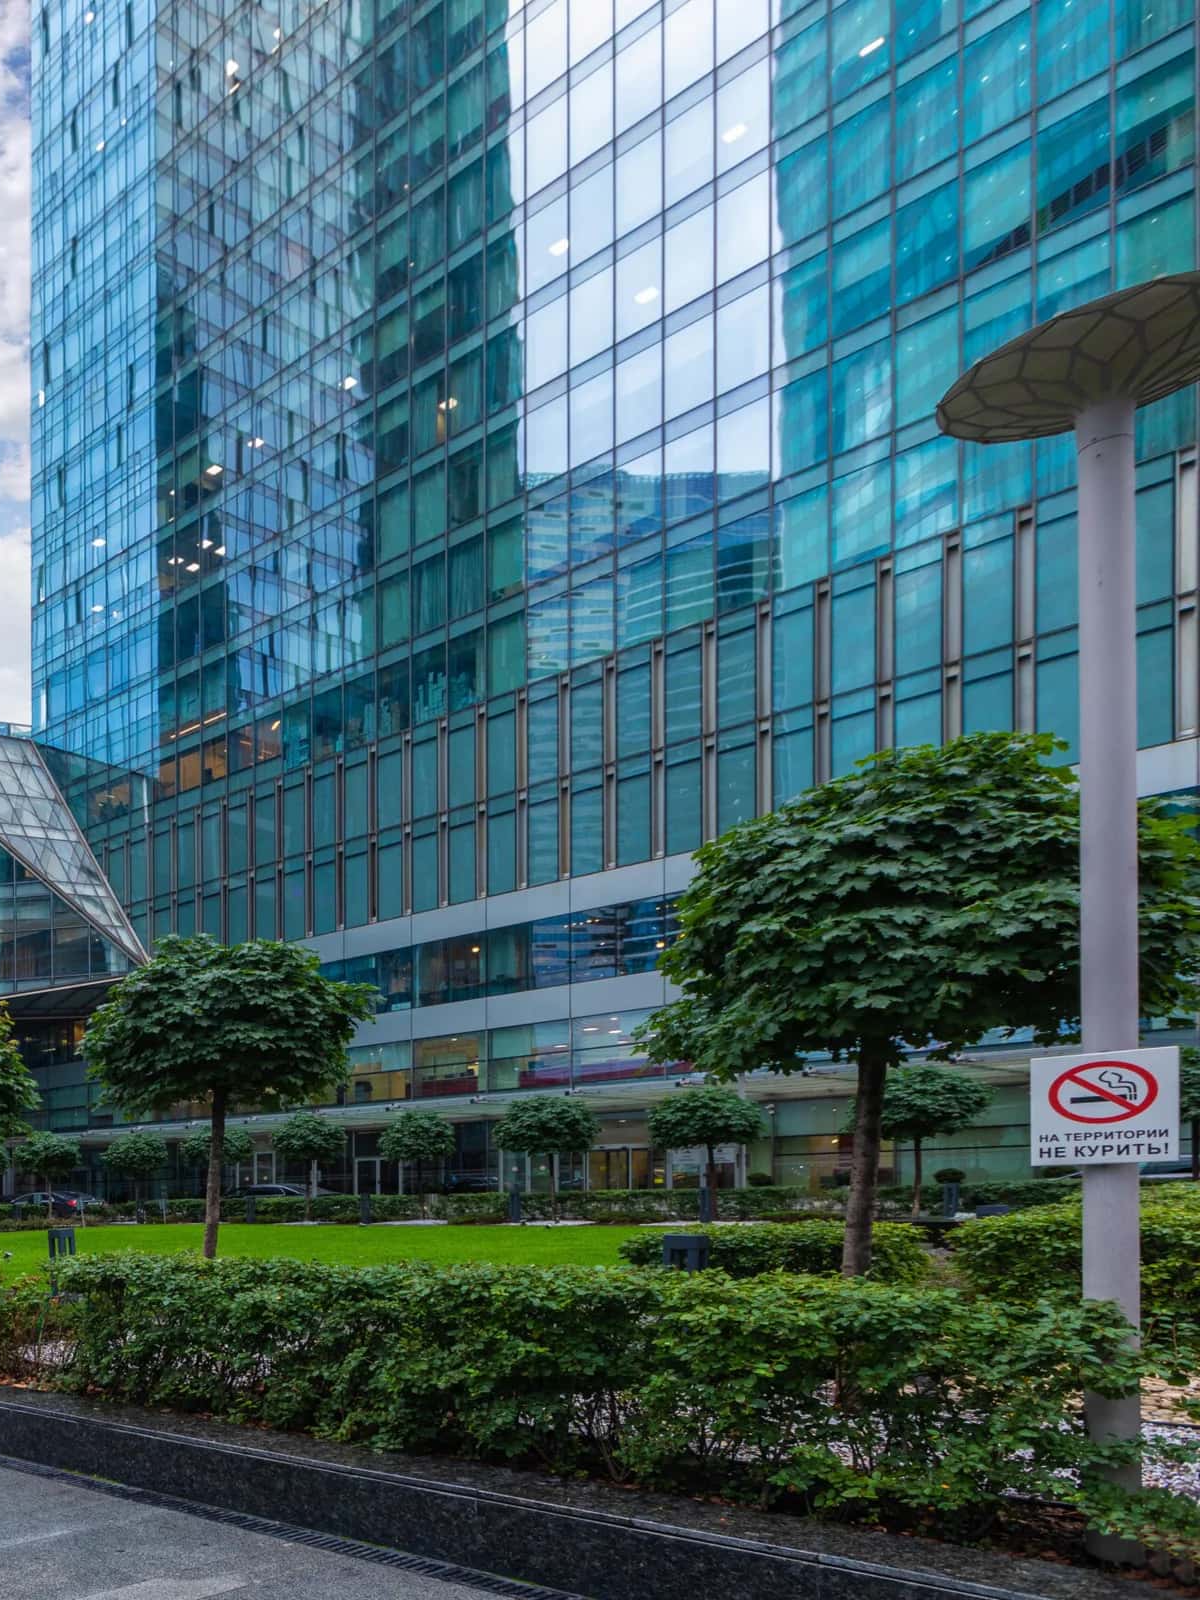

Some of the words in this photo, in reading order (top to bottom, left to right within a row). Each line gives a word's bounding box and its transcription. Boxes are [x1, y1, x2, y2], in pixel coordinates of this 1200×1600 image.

[1039, 1134, 1060, 1143] НА
[1064, 1128, 1169, 1142] ТЕРРИТОРИИ
[1039, 1146, 1067, 1159] НЕ
[1074, 1142, 1169, 1158] КУРИТЬ!
